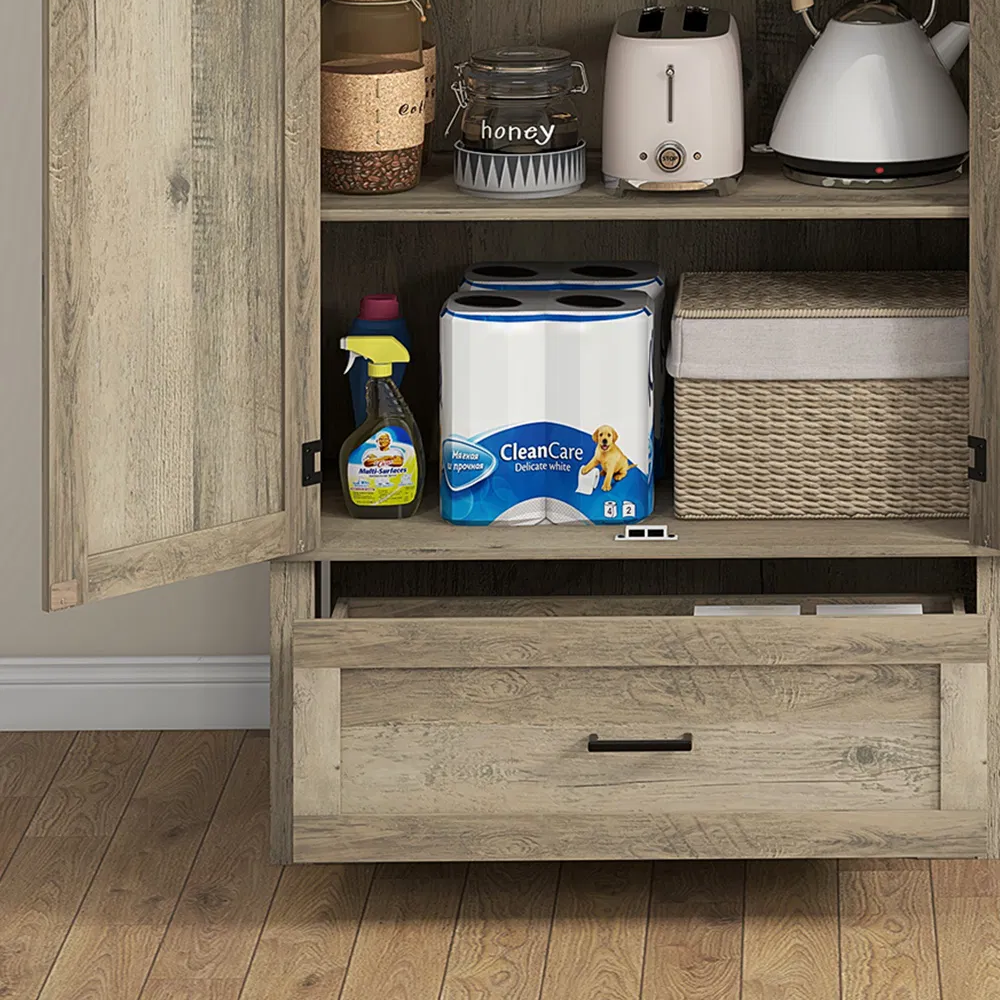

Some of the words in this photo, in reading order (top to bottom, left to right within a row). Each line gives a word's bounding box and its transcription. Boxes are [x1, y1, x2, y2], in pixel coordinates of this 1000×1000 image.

[481, 119, 555, 146] honey
[500, 441, 584, 461] CleanCare
[359, 467, 407, 475] Multi-Surfaces
[515, 462, 547, 472] Delicate
[549, 461, 571, 472] white
[607, 507, 612, 515] 4
[626, 506, 631, 514] 2
